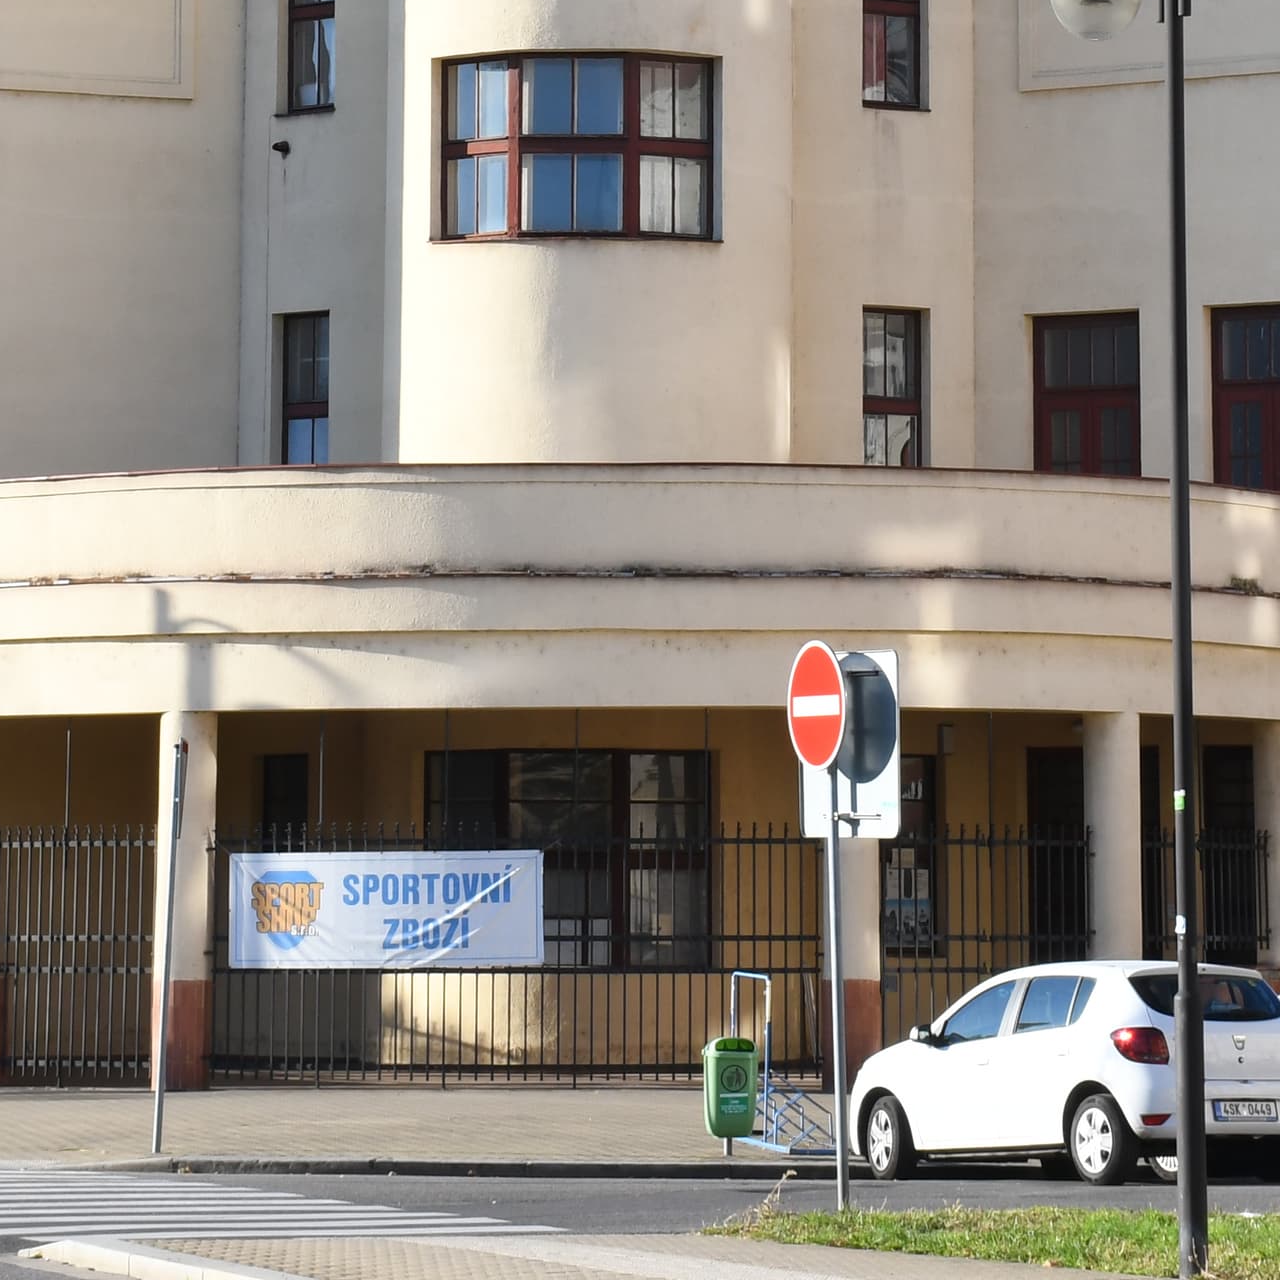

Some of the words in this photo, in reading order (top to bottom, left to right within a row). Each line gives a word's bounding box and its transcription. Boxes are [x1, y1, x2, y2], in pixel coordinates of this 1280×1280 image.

[251, 881, 325, 910] SPORT
[342, 864, 512, 906] SPORTOVNÍ
[382, 908, 470, 950] ZBOŽÍ
